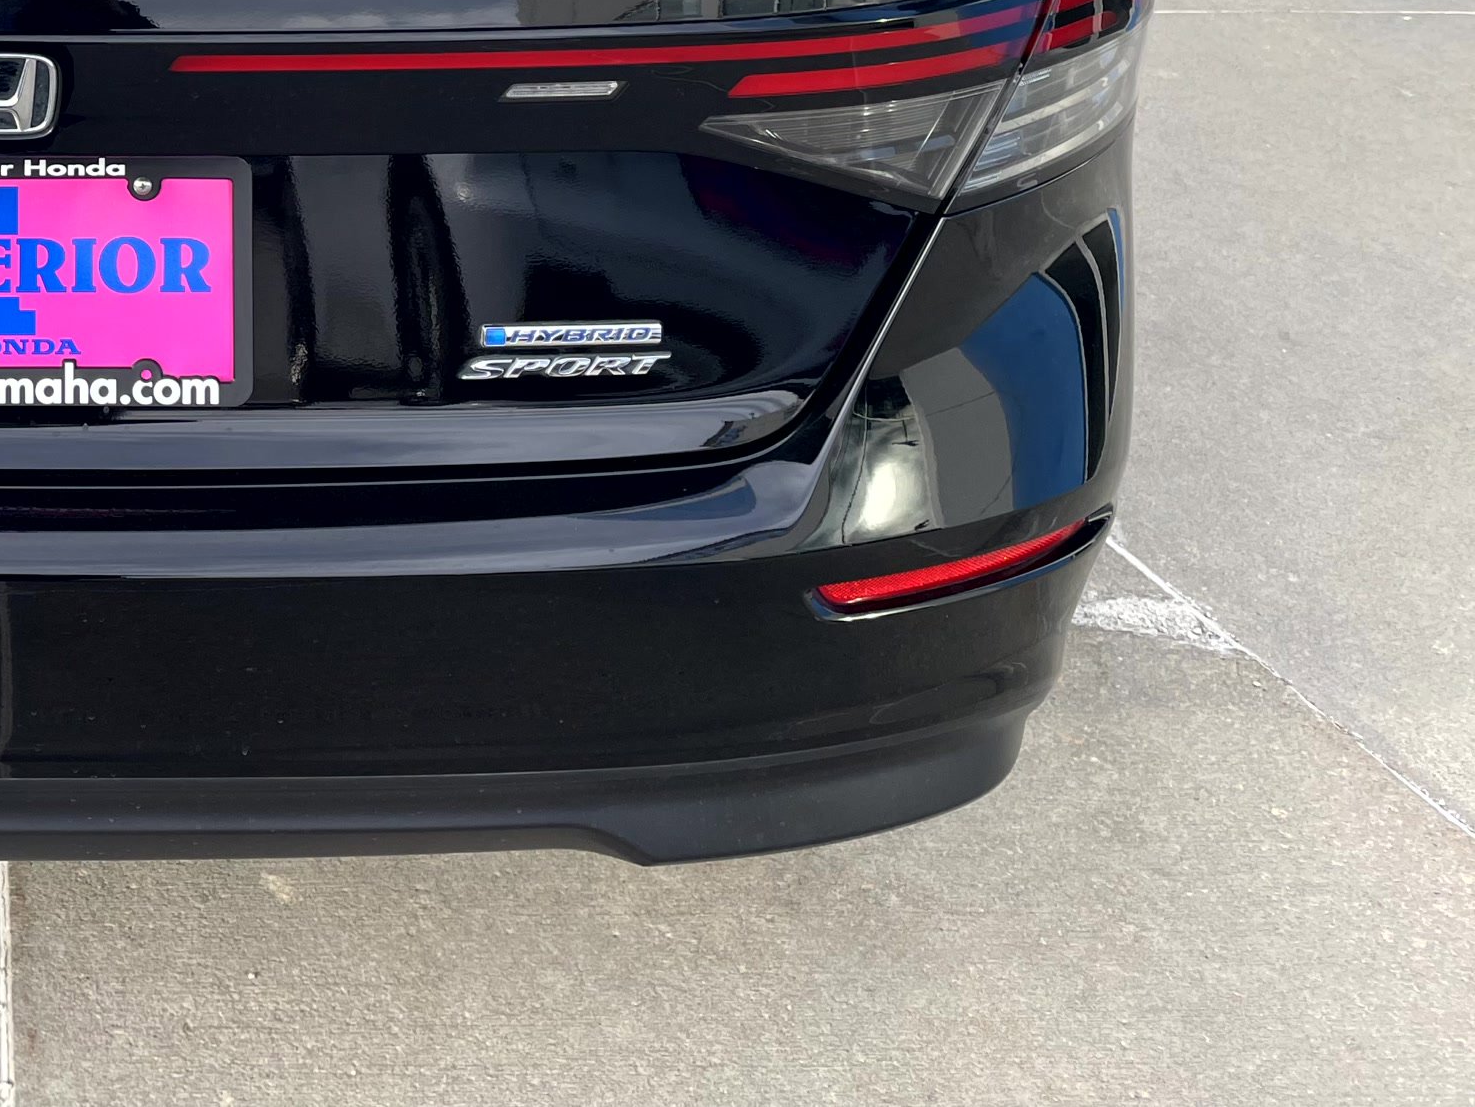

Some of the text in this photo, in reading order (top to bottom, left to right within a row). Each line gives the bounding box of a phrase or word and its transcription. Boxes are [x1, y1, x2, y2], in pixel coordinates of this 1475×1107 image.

[23, 158, 126, 178] Honda
[510, 326, 652, 343] HYBRID
[460, 351, 672, 380] SPORT
